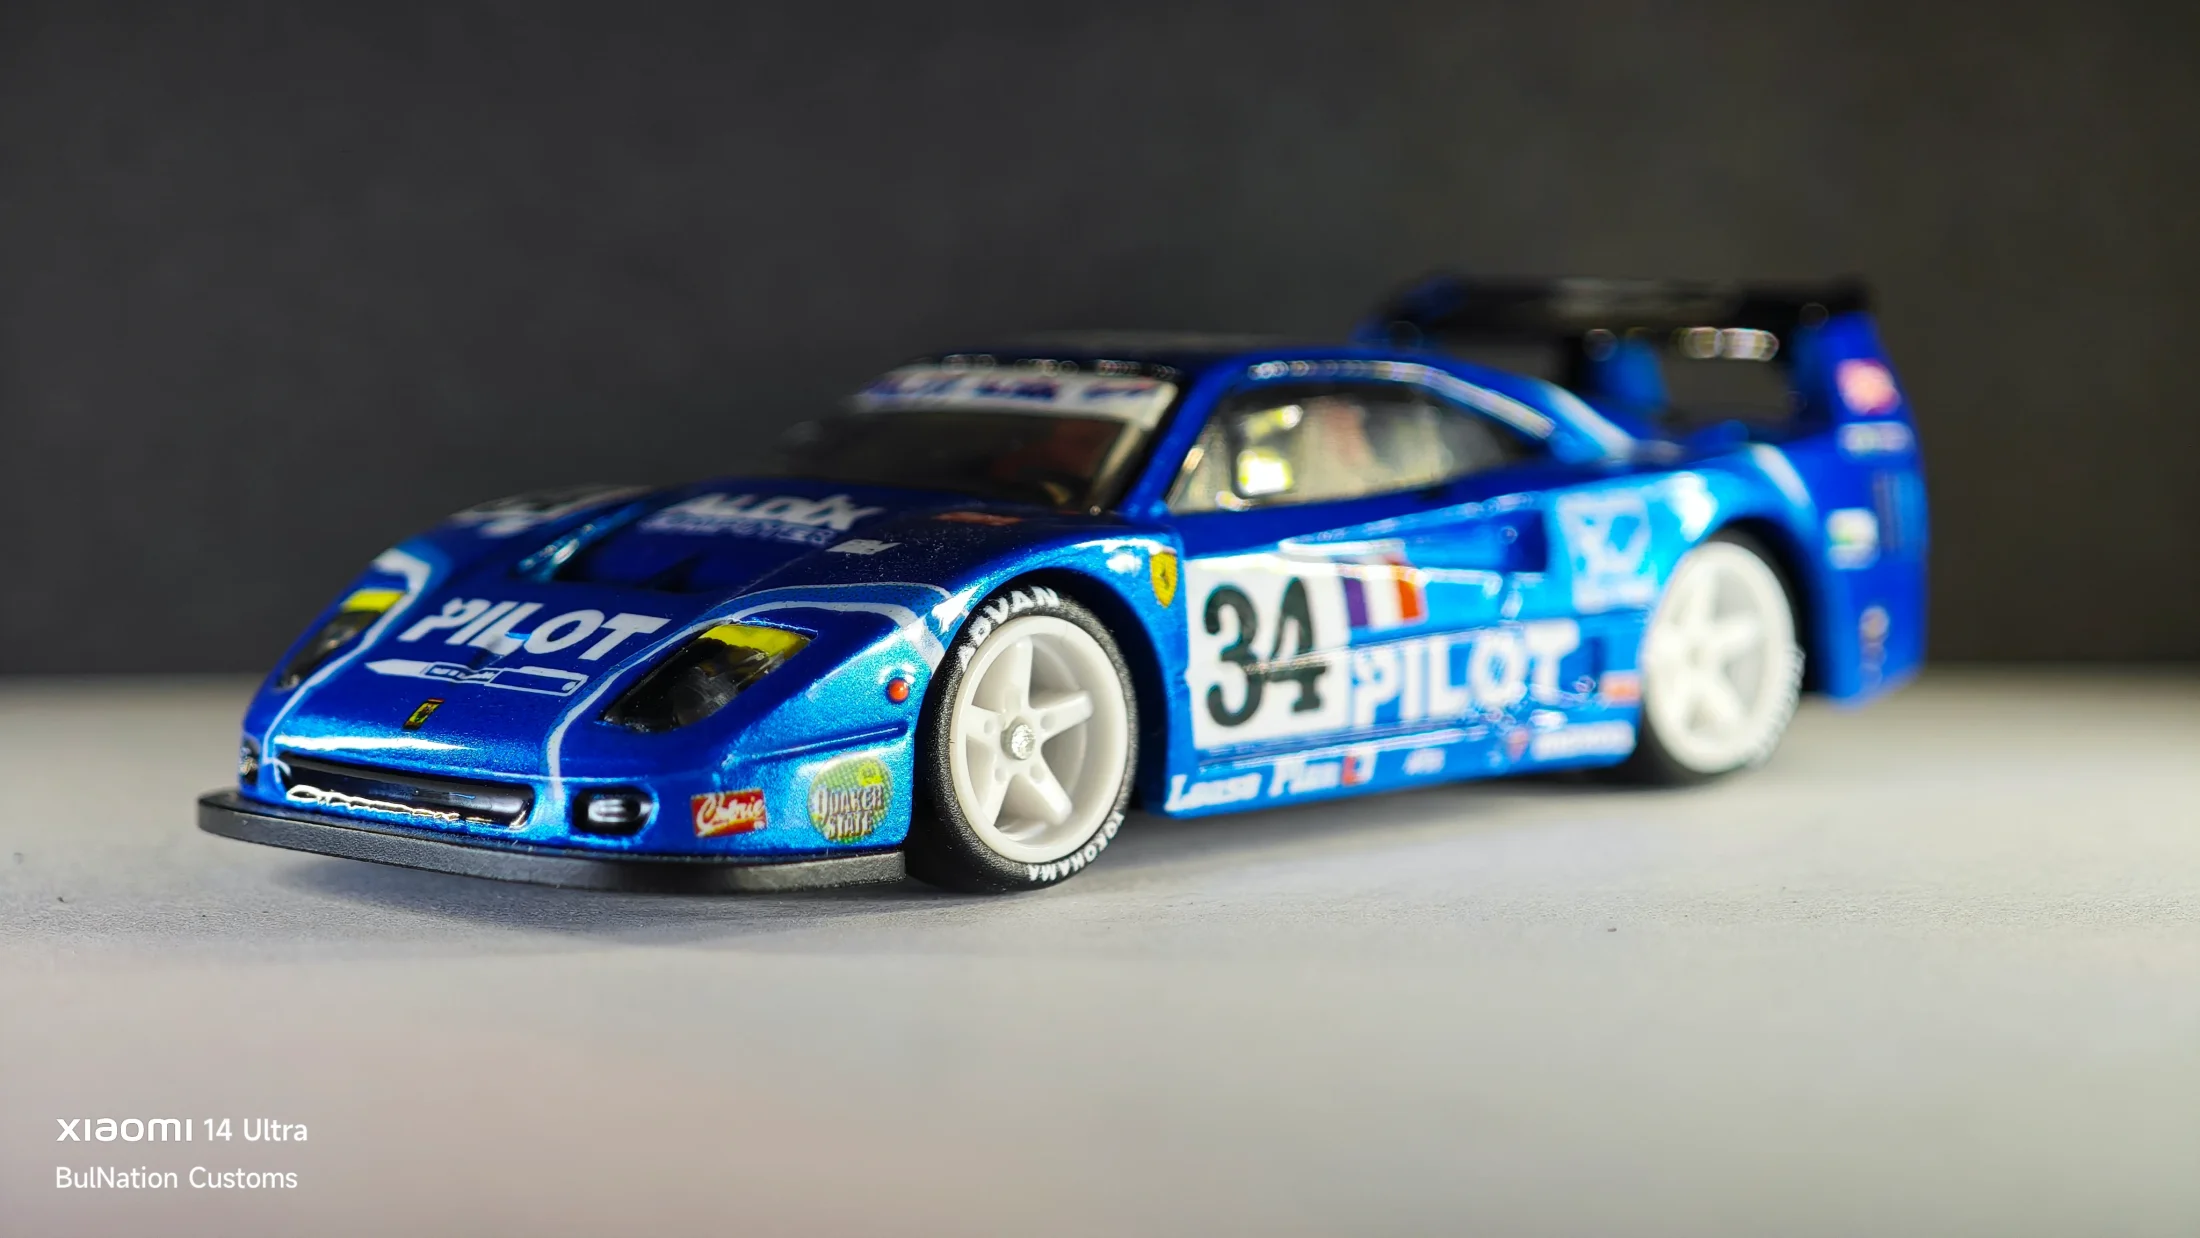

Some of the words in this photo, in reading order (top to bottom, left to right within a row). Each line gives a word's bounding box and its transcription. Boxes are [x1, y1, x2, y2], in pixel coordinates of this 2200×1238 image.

[397, 597, 673, 661] PILOT
[958, 585, 1061, 673] ADVAN
[1203, 577, 1328, 727] 34
[1350, 618, 1580, 729] PILOT
[811, 782, 887, 826] QUAKER
[825, 809, 876, 841] STATE
[1028, 811, 1125, 882] YOKOHAMA
